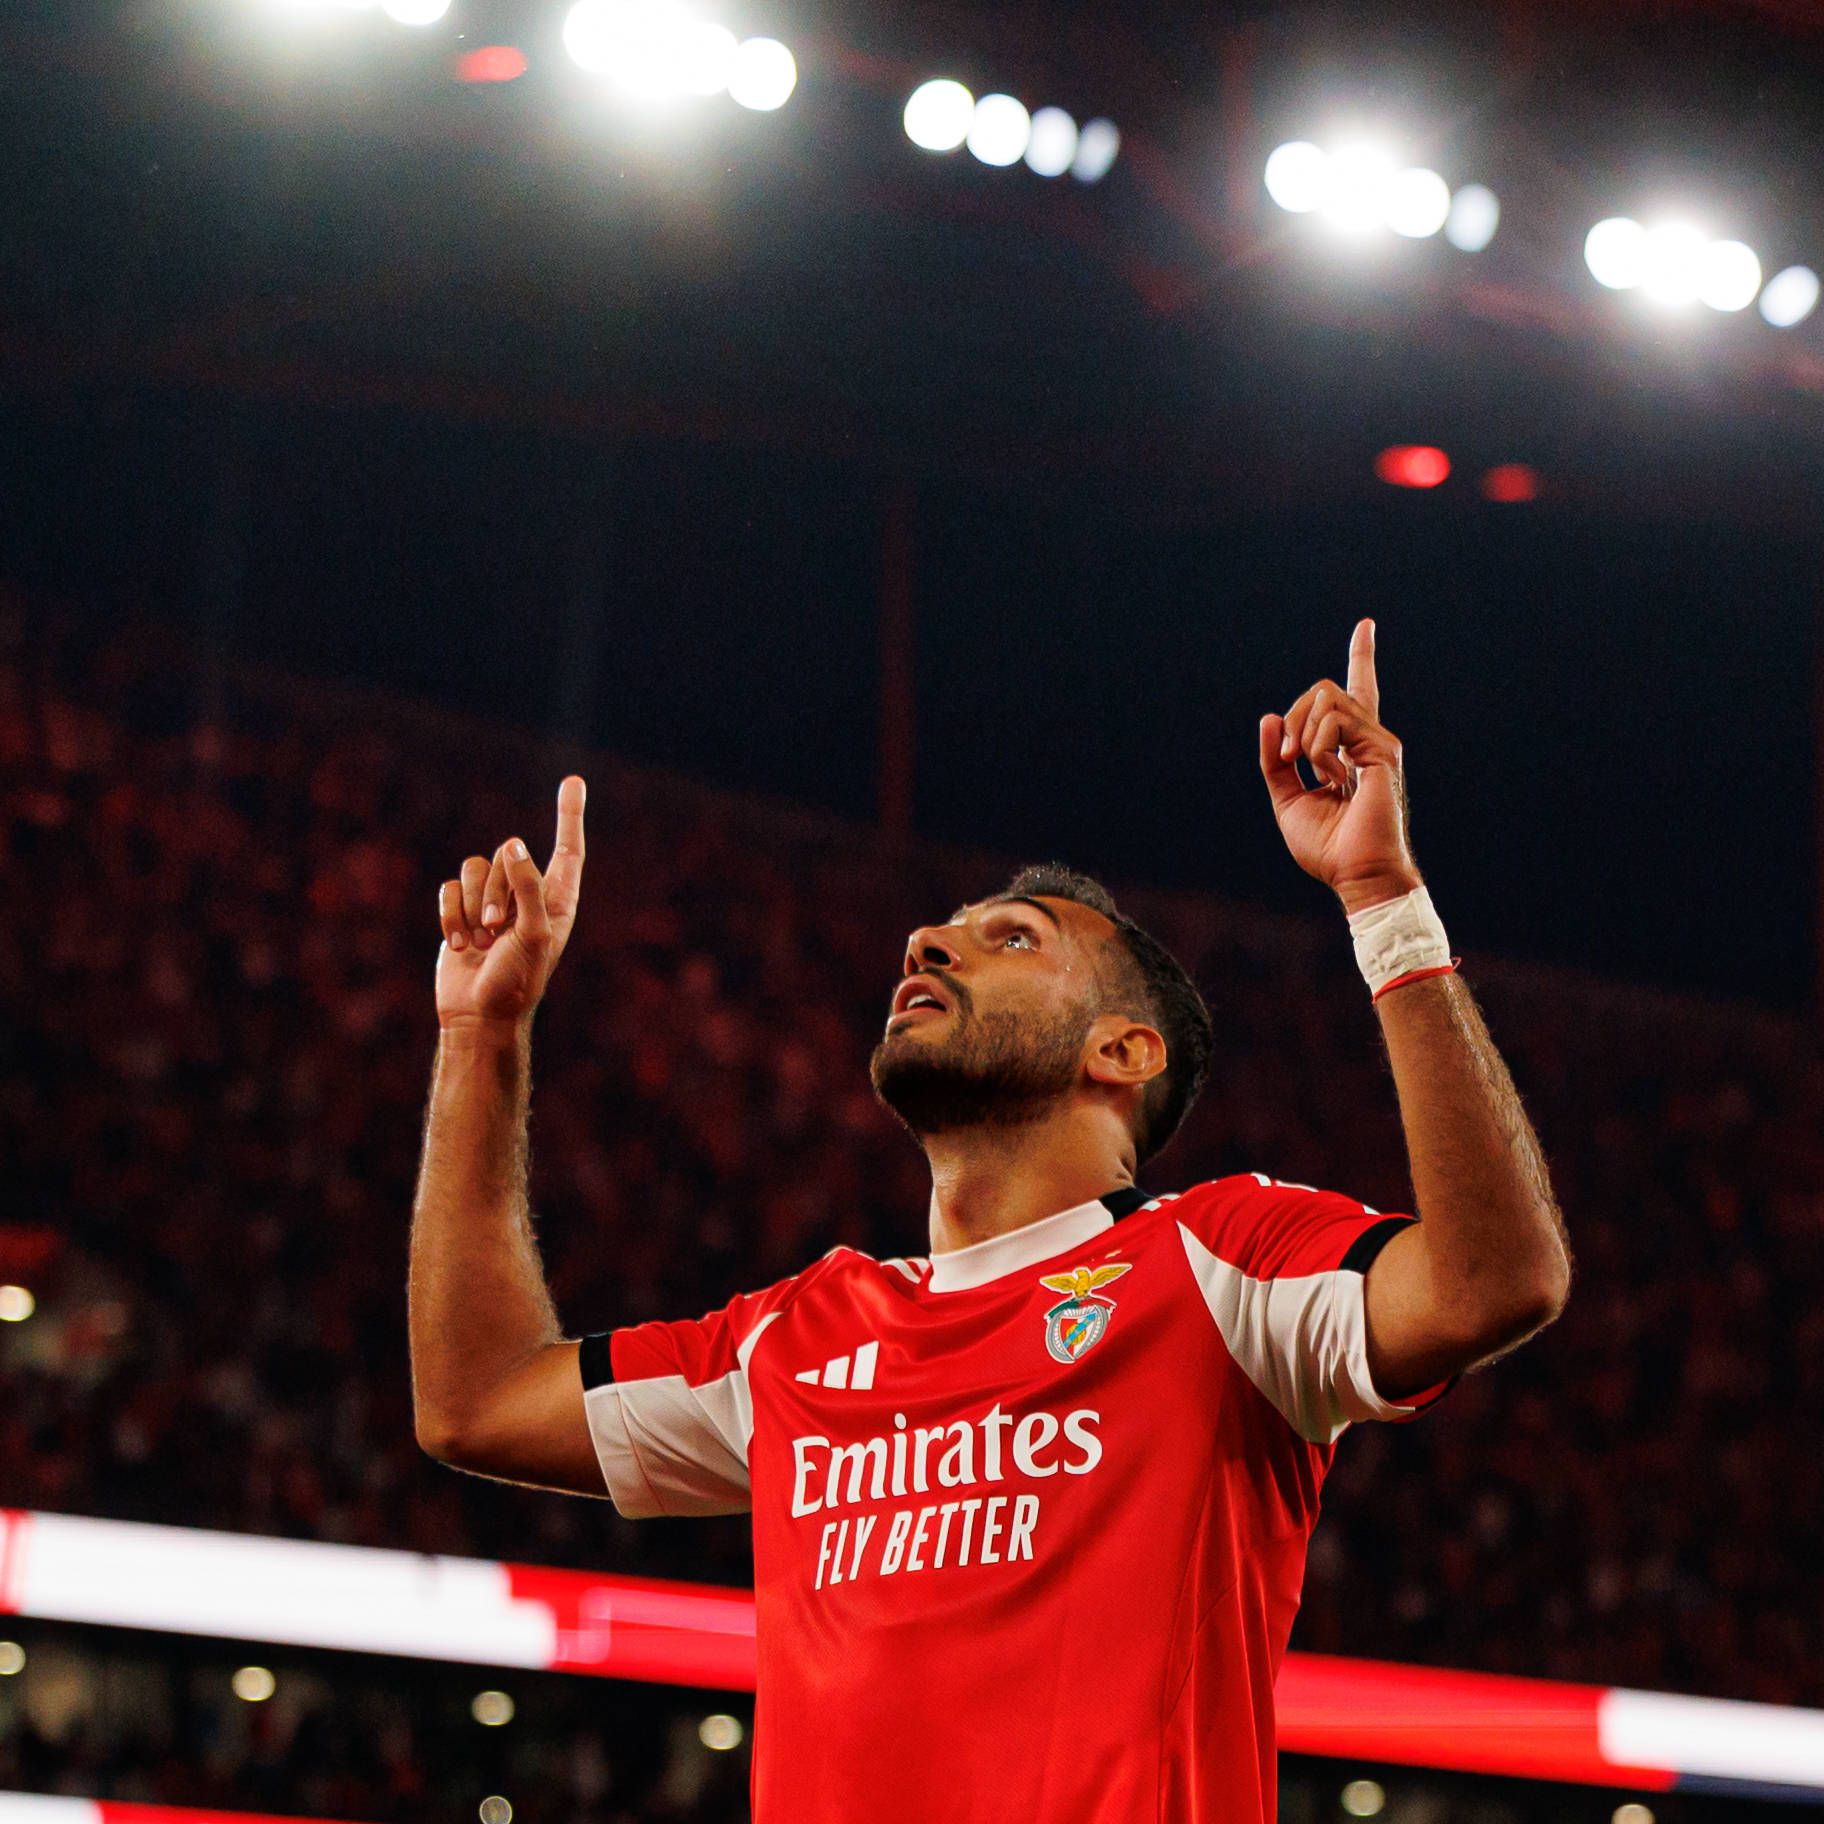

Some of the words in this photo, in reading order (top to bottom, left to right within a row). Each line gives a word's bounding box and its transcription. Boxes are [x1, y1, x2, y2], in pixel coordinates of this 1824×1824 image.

[790, 1402, 1104, 1520] Emirates
[815, 1514, 878, 1591] FLY
[880, 1493, 1041, 1578] BETTER
